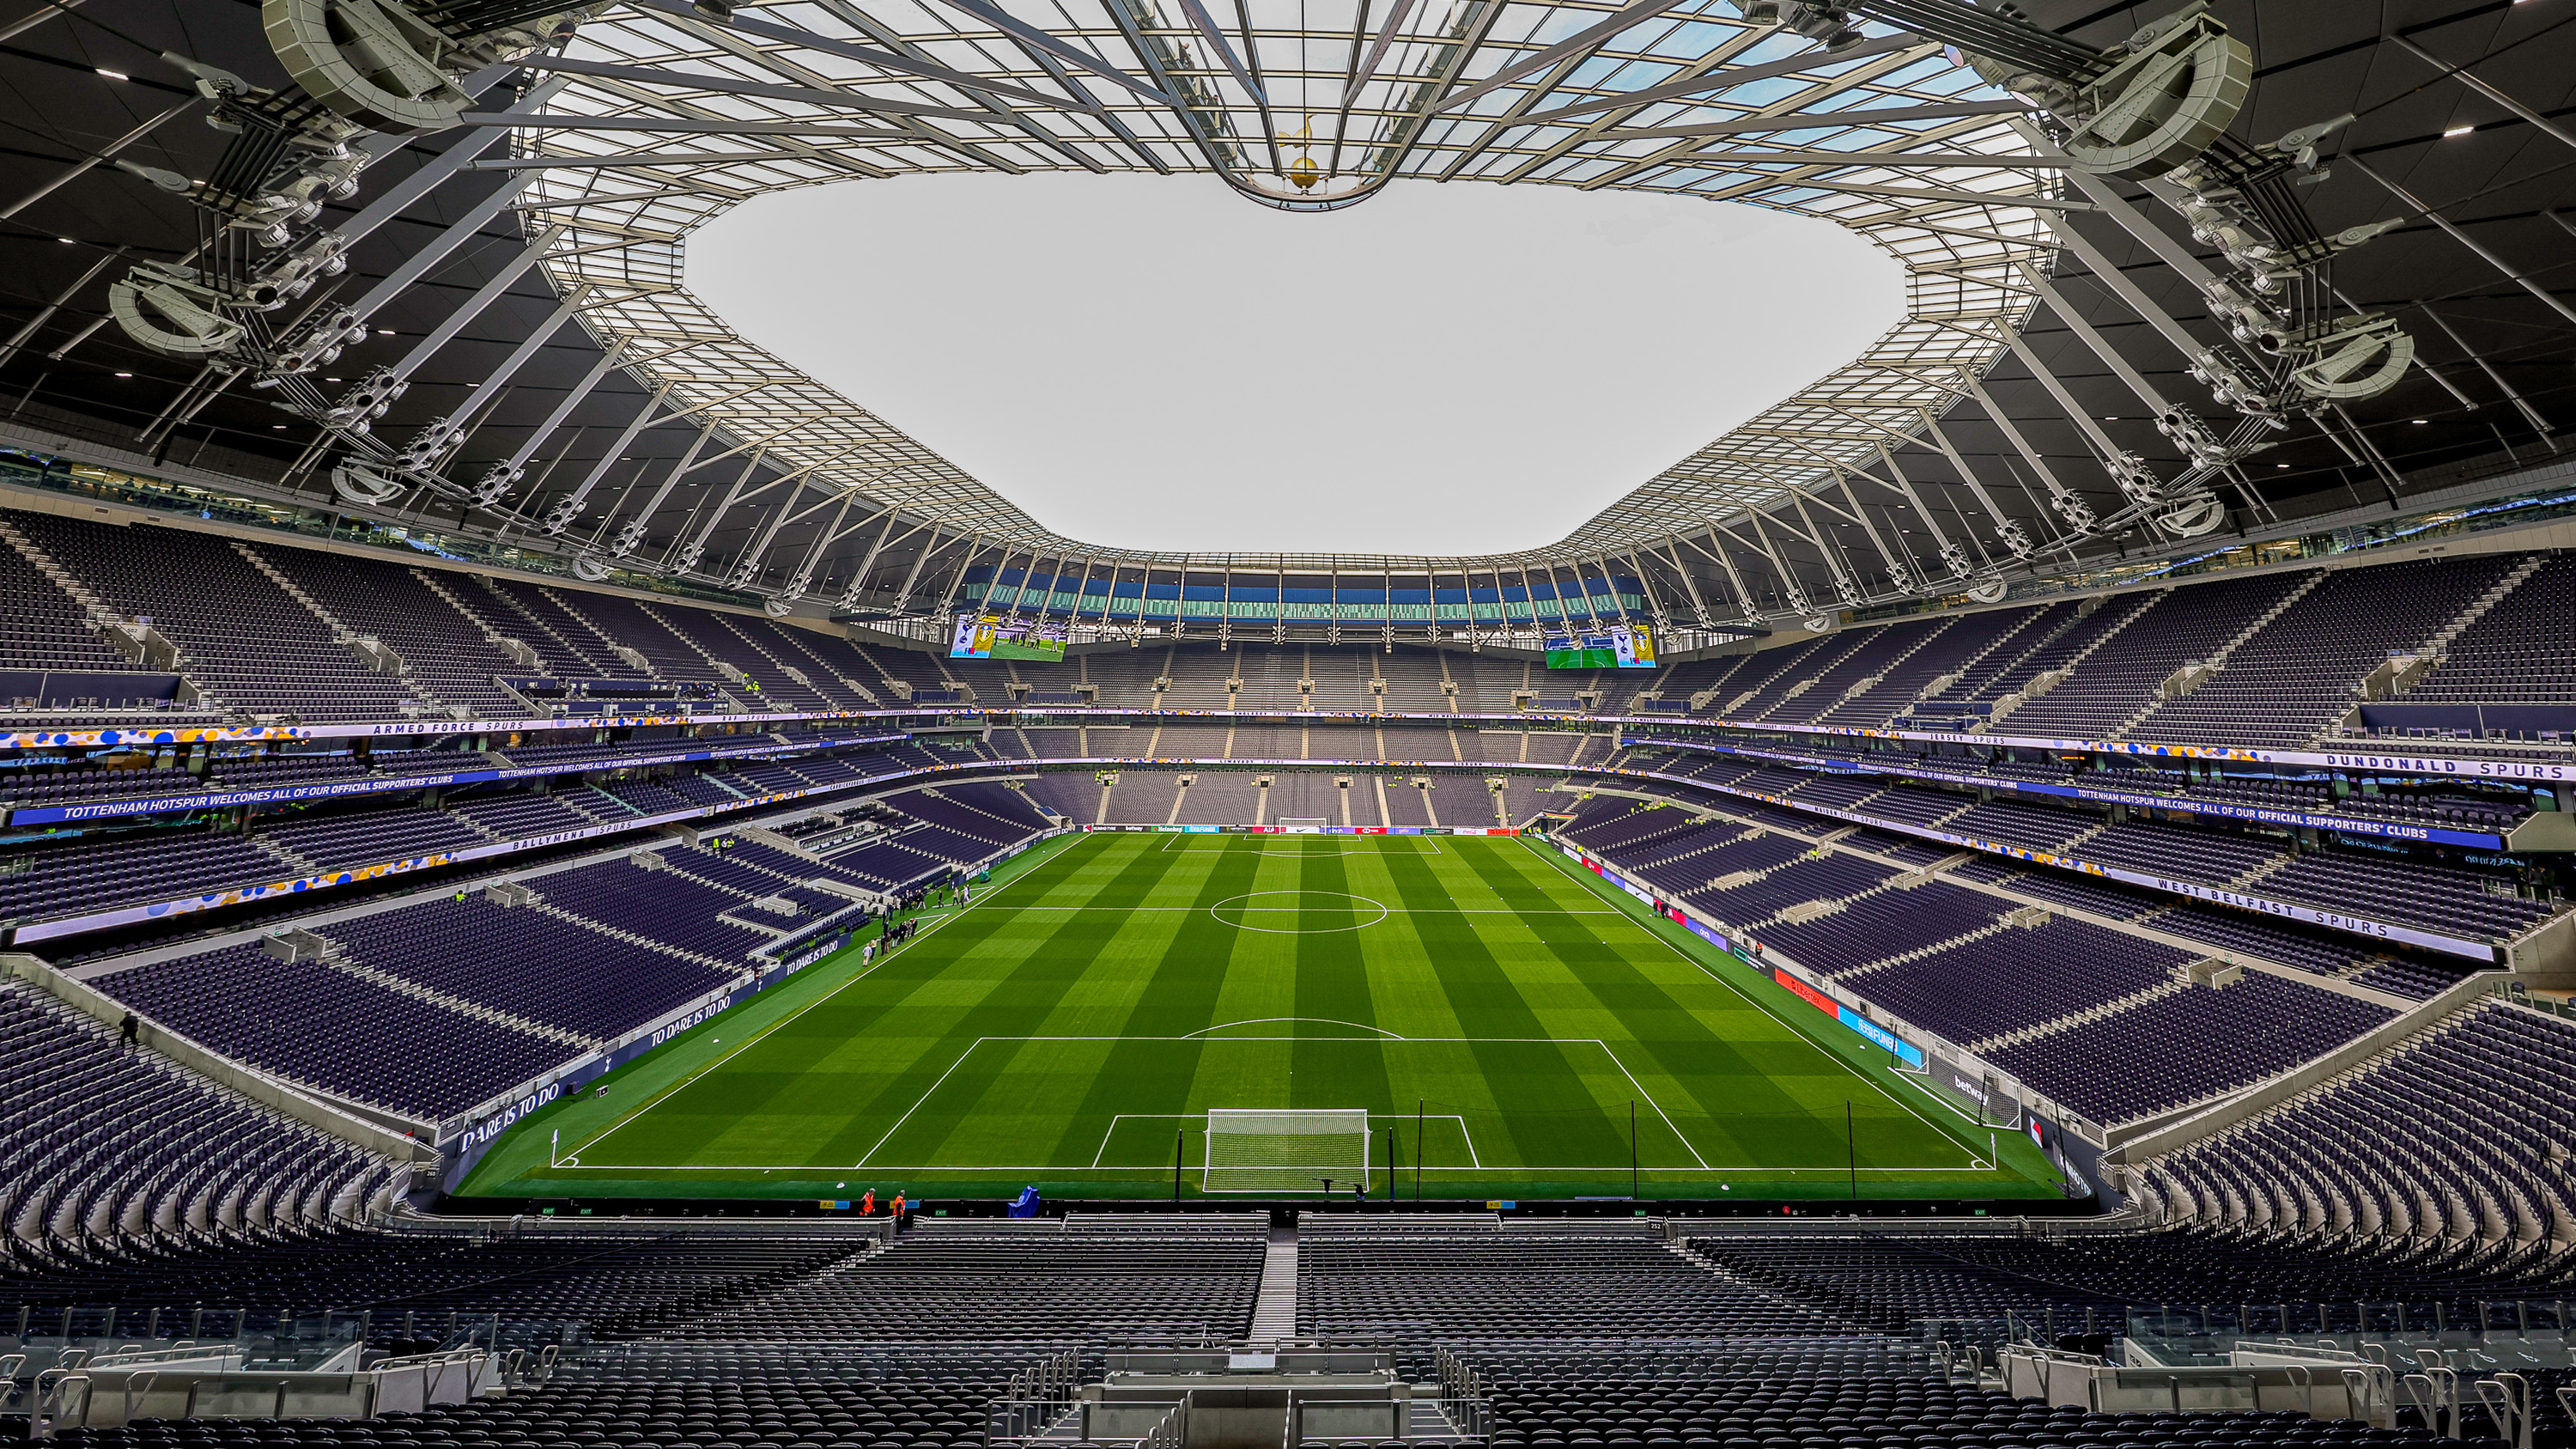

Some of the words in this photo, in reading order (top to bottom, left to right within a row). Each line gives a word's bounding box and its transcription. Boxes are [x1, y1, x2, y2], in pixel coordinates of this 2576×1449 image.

[374, 724, 425, 734] ARMED
[432, 722, 475, 732] FORCE
[486, 721, 525, 730] SPURS
[1930, 734, 1963, 742] JERSEY
[1973, 736, 2005, 744] SPURS
[498, 768, 536, 778] TOTTENHAM
[537, 765, 563, 774] HOTSPUR
[563, 763, 594, 772] WELCOMES
[2327, 755, 2456, 772] DUNDONALD
[2480, 763, 2563, 779] SPURS
[64, 801, 149, 819] TOTTENHAM
[149, 796, 207, 811] HOTSPUR
[209, 791, 270, 805] WELCOMES
[272, 790, 292, 800] ALL
[293, 788, 308, 798] OF
[309, 786, 329, 796] OUR
[331, 782, 371, 794] OFFICIAL
[372, 777, 428, 791] SUPPORTERS'
[429, 775, 453, 784] CLUBS
[1814, 806, 1837, 816] MAIDEN
[1840, 812, 1855, 820] CITY
[1861, 816, 1883, 827] SPURS
[2077, 789, 2119, 802] TOTTENHAM
[2120, 794, 2155, 806] HOTSPUR
[2156, 798, 2201, 812] WELCOMES
[2203, 804, 2221, 814] ALL
[2221, 806, 2233, 816] OF
[2235, 807, 2256, 819] OUR
[2258, 810, 2304, 825] OFFICIAL
[2306, 816, 2384, 833] SUPPORTERS'
[2386, 825, 2428, 839] CLUBS
[513, 830, 585, 850] BALLYMENA
[599, 822, 632, 834] SPURS
[2158, 879, 2200, 896] WEST
[2211, 890, 2293, 916] BELFAST
[2315, 912, 2388, 936] SPURS
[787, 962, 795, 976] TO
[796, 952, 813, 971] DARE
[813, 949, 820, 962] IS
[820, 945, 828, 958] TO
[829, 940, 838, 953] DO
[1796, 983, 1820, 1006] Libertex
[651, 1029, 665, 1047] TO
[666, 1014, 693, 1039] DARE
[694, 1009, 704, 1025] IS
[705, 1003, 716, 1019] TO
[717, 996, 730, 1013] DO
[1954, 1075, 1989, 1106] betway
[461, 1114, 502, 1153] DARE
[503, 1105, 516, 1127] IS
[519, 1095, 537, 1117] TO
[538, 1083, 559, 1108] DO
